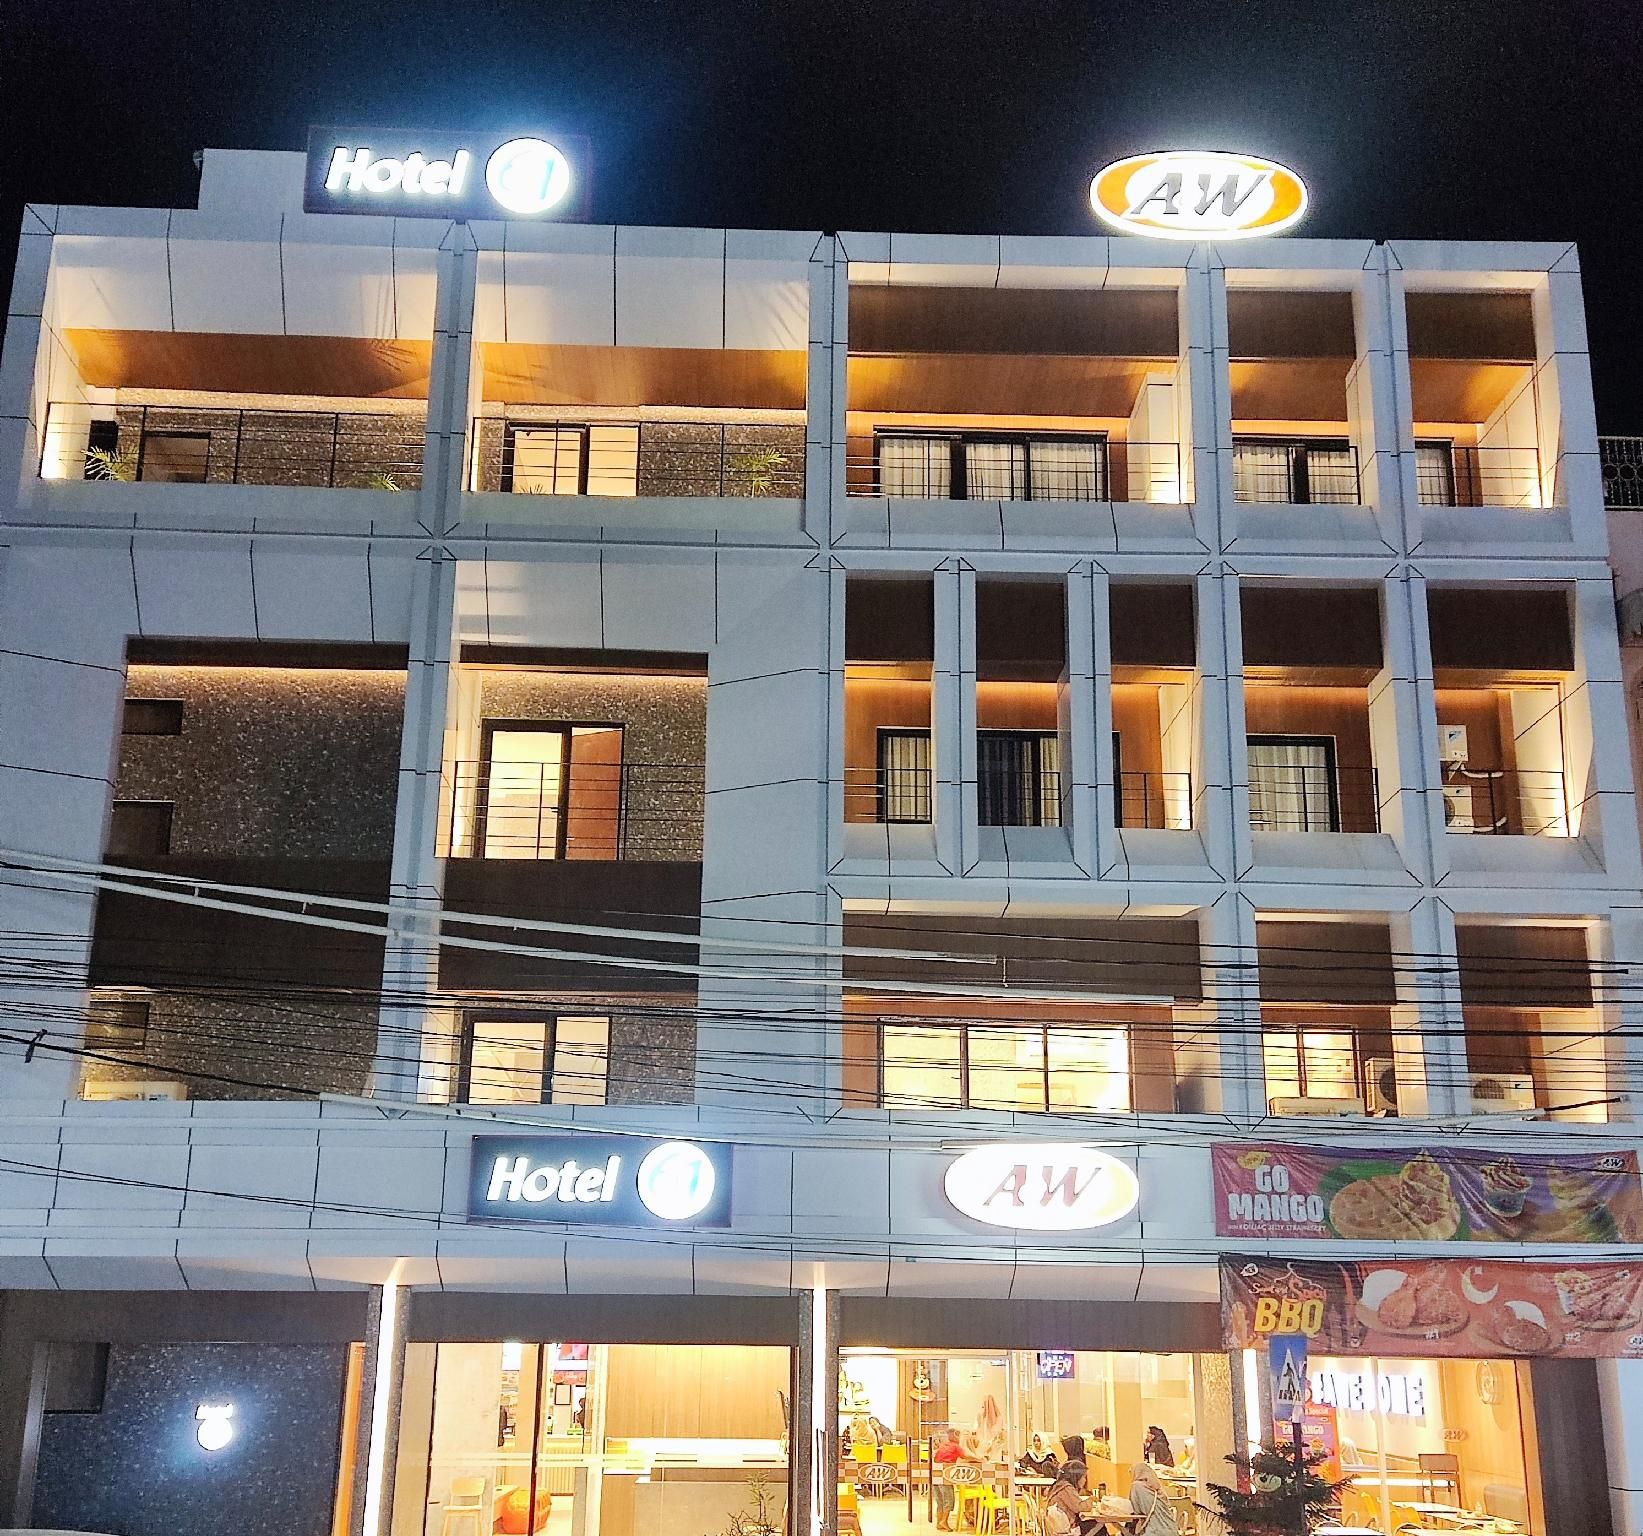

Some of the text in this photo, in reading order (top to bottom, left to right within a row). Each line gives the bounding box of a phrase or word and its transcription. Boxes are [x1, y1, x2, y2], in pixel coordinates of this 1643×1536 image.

[324, 146, 469, 194] Hotel
[486, 1155, 621, 1202] Hotel
[1255, 1164, 1289, 1193] GO
[1228, 1193, 1325, 1223] MANGO
[1254, 1297, 1324, 1338] BBQ
[1040, 1358, 1073, 1373] OPEN
